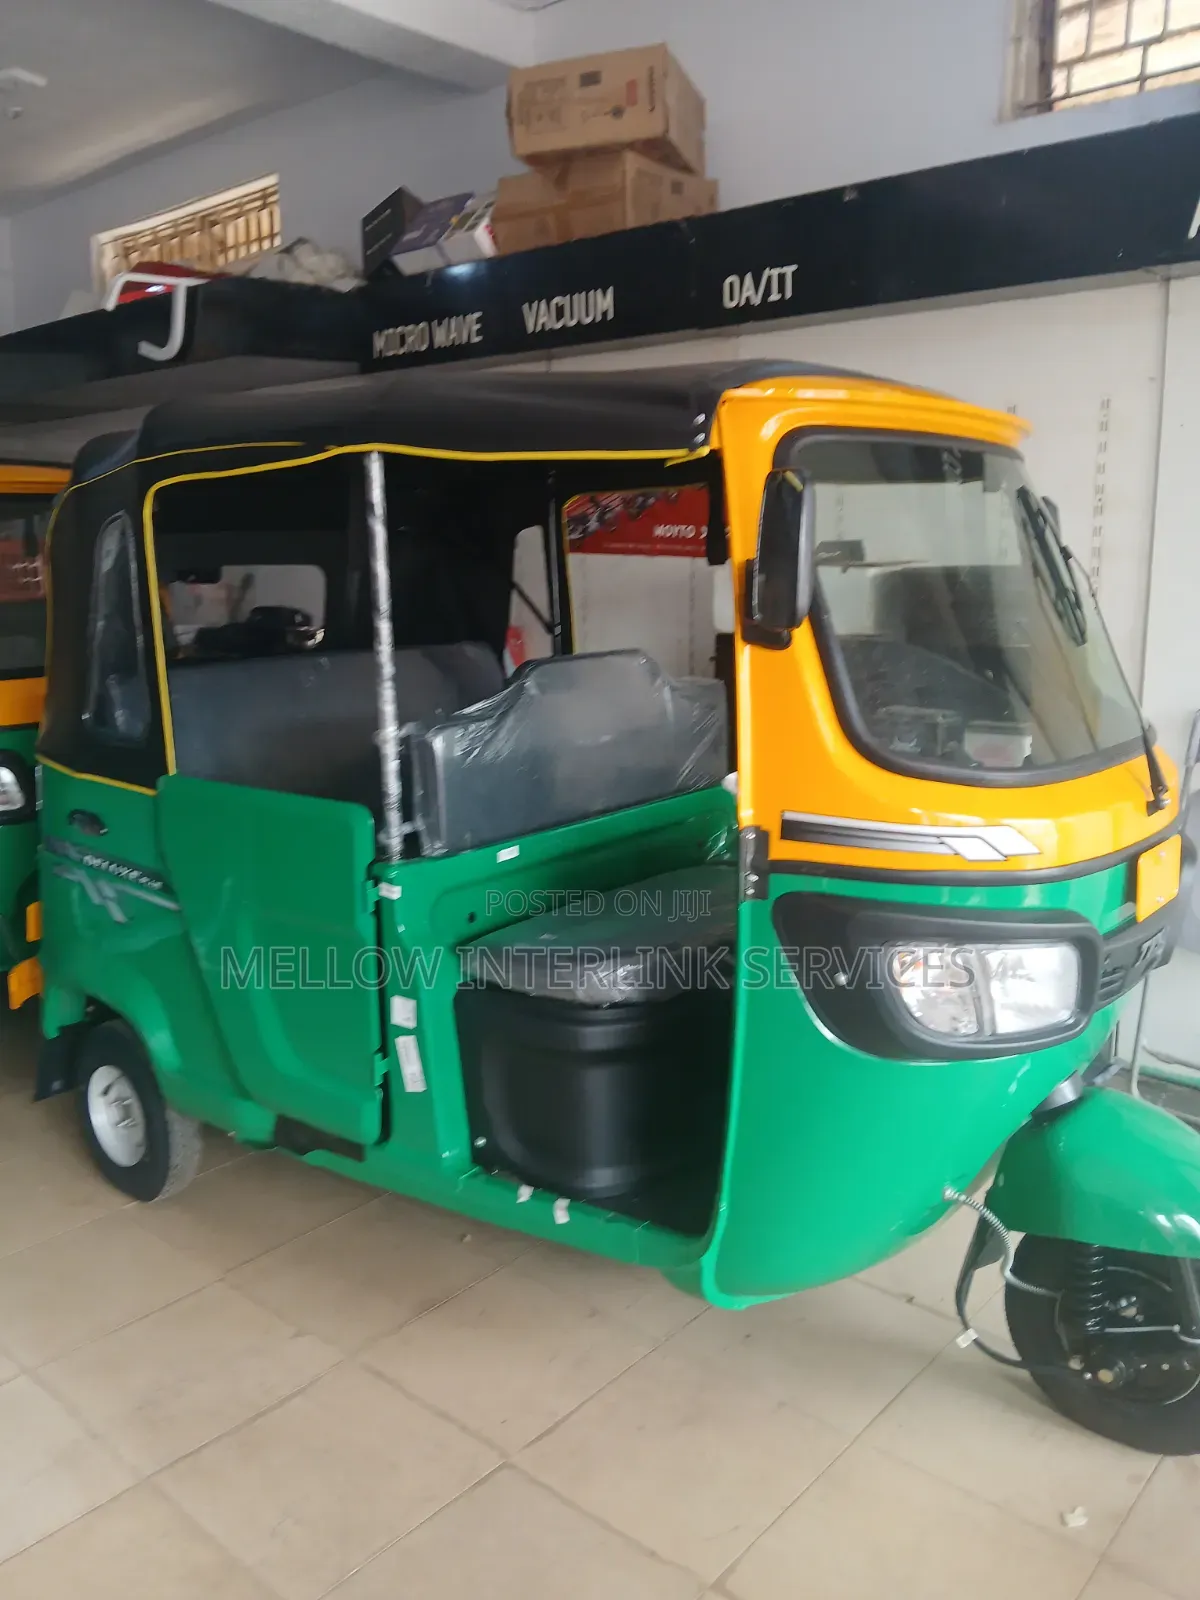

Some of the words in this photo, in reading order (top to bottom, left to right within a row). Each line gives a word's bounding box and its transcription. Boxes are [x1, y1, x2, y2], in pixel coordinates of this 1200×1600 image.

[521, 285, 614, 335] VACUUM
[722, 263, 799, 309] OA/IT
[372, 321, 430, 359] MICRO
[431, 311, 483, 349] WAVE
